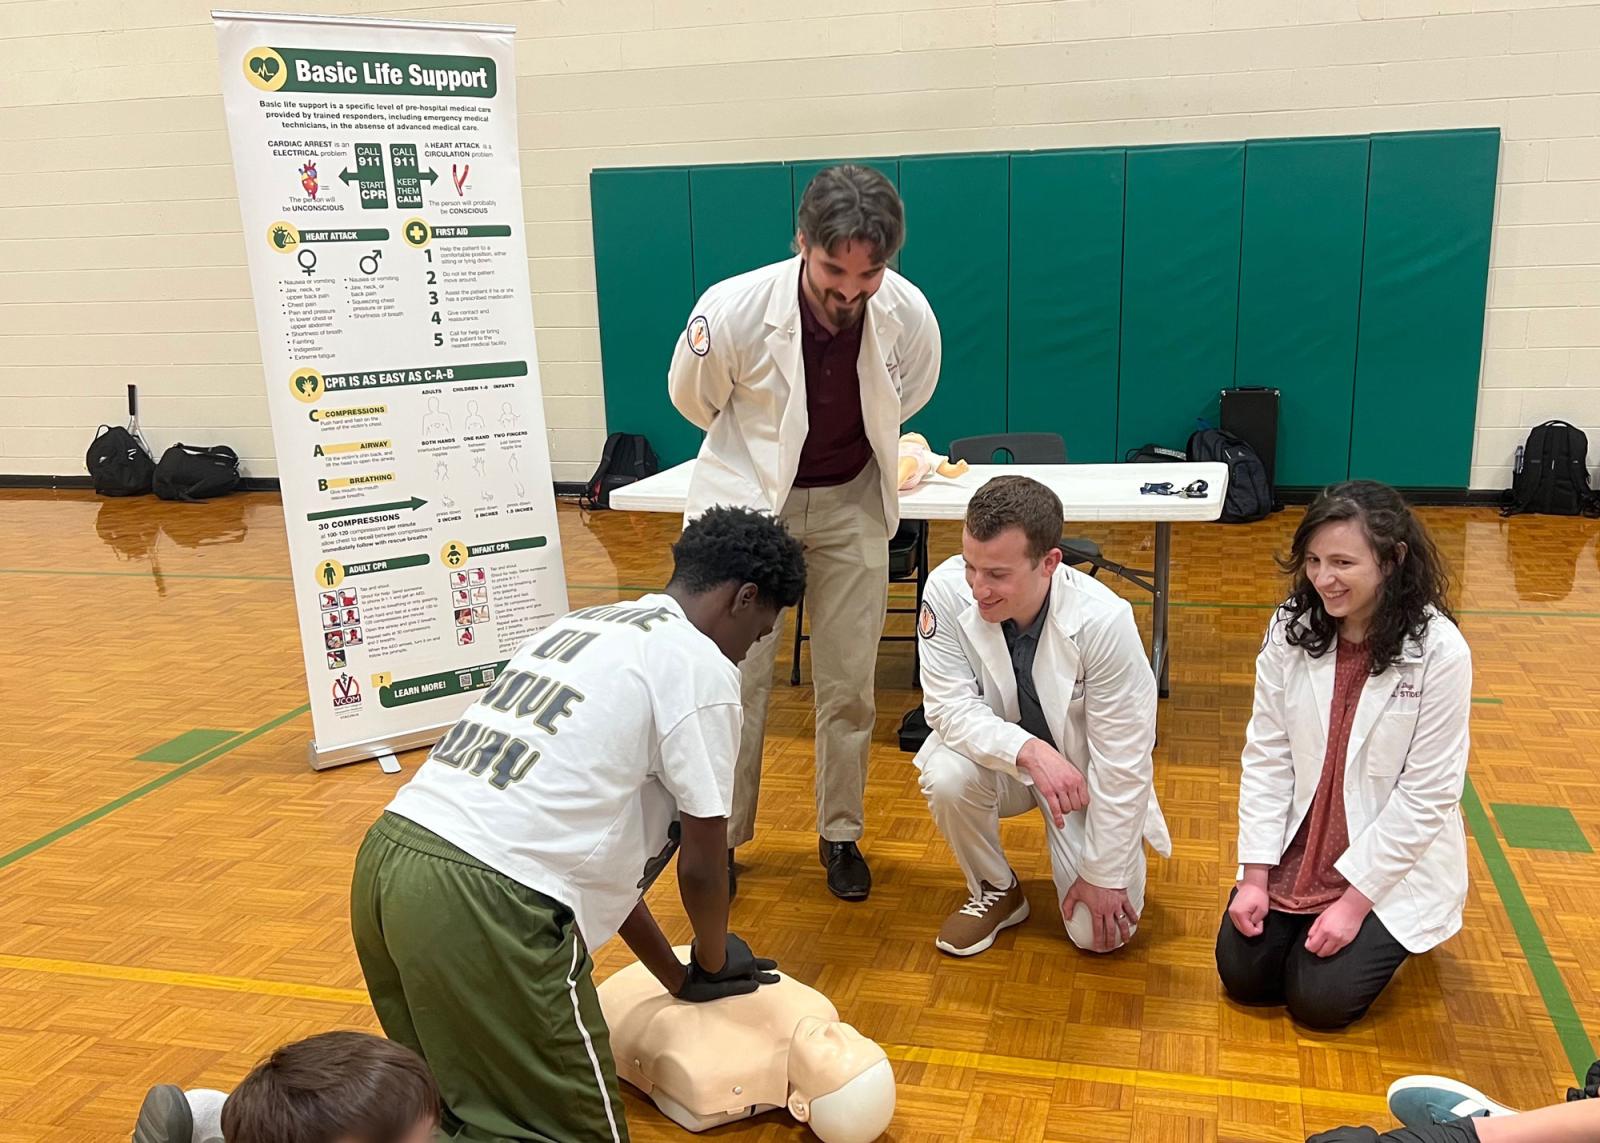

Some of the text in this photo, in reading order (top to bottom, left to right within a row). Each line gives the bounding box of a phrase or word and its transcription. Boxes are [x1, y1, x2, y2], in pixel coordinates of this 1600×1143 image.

[295, 59, 488, 91] Basic Life Support
[345, 102, 374, 110] specific
[404, 104, 448, 112] pre-hospital
[387, 113, 422, 121] including
[356, 147, 380, 155] CALL
[392, 147, 414, 155] CALL
[357, 156, 380, 166] 911
[393, 157, 415, 166] 911
[361, 189, 386, 199] CPR
[305, 231, 358, 240] HEART ATTACK
[435, 228, 455, 236] FIRST
[423, 248, 432, 262] 1
[425, 270, 436, 284] 2
[428, 291, 438, 304] 3
[430, 311, 442, 324] 4
[433, 332, 443, 346] 5
[325, 368, 454, 388] CPR IS AS EASY AS C-A-B
[308, 409, 319, 422] C
[324, 406, 385, 417] COMPRESSIONS
[359, 440, 388, 449] AIRWAY
[312, 444, 324, 457] A
[349, 473, 392, 484] BREATHING
[317, 478, 328, 491] B
[318, 513, 400, 530] 30 COMPRESSIONS
[322, 544, 355, 553] immediately
[471, 543, 509, 554] INFANT CPR
[348, 561, 387, 573] ADULT CPR
[393, 680, 446, 698] LEARN MORE!
[334, 694, 360, 706] VCOM
